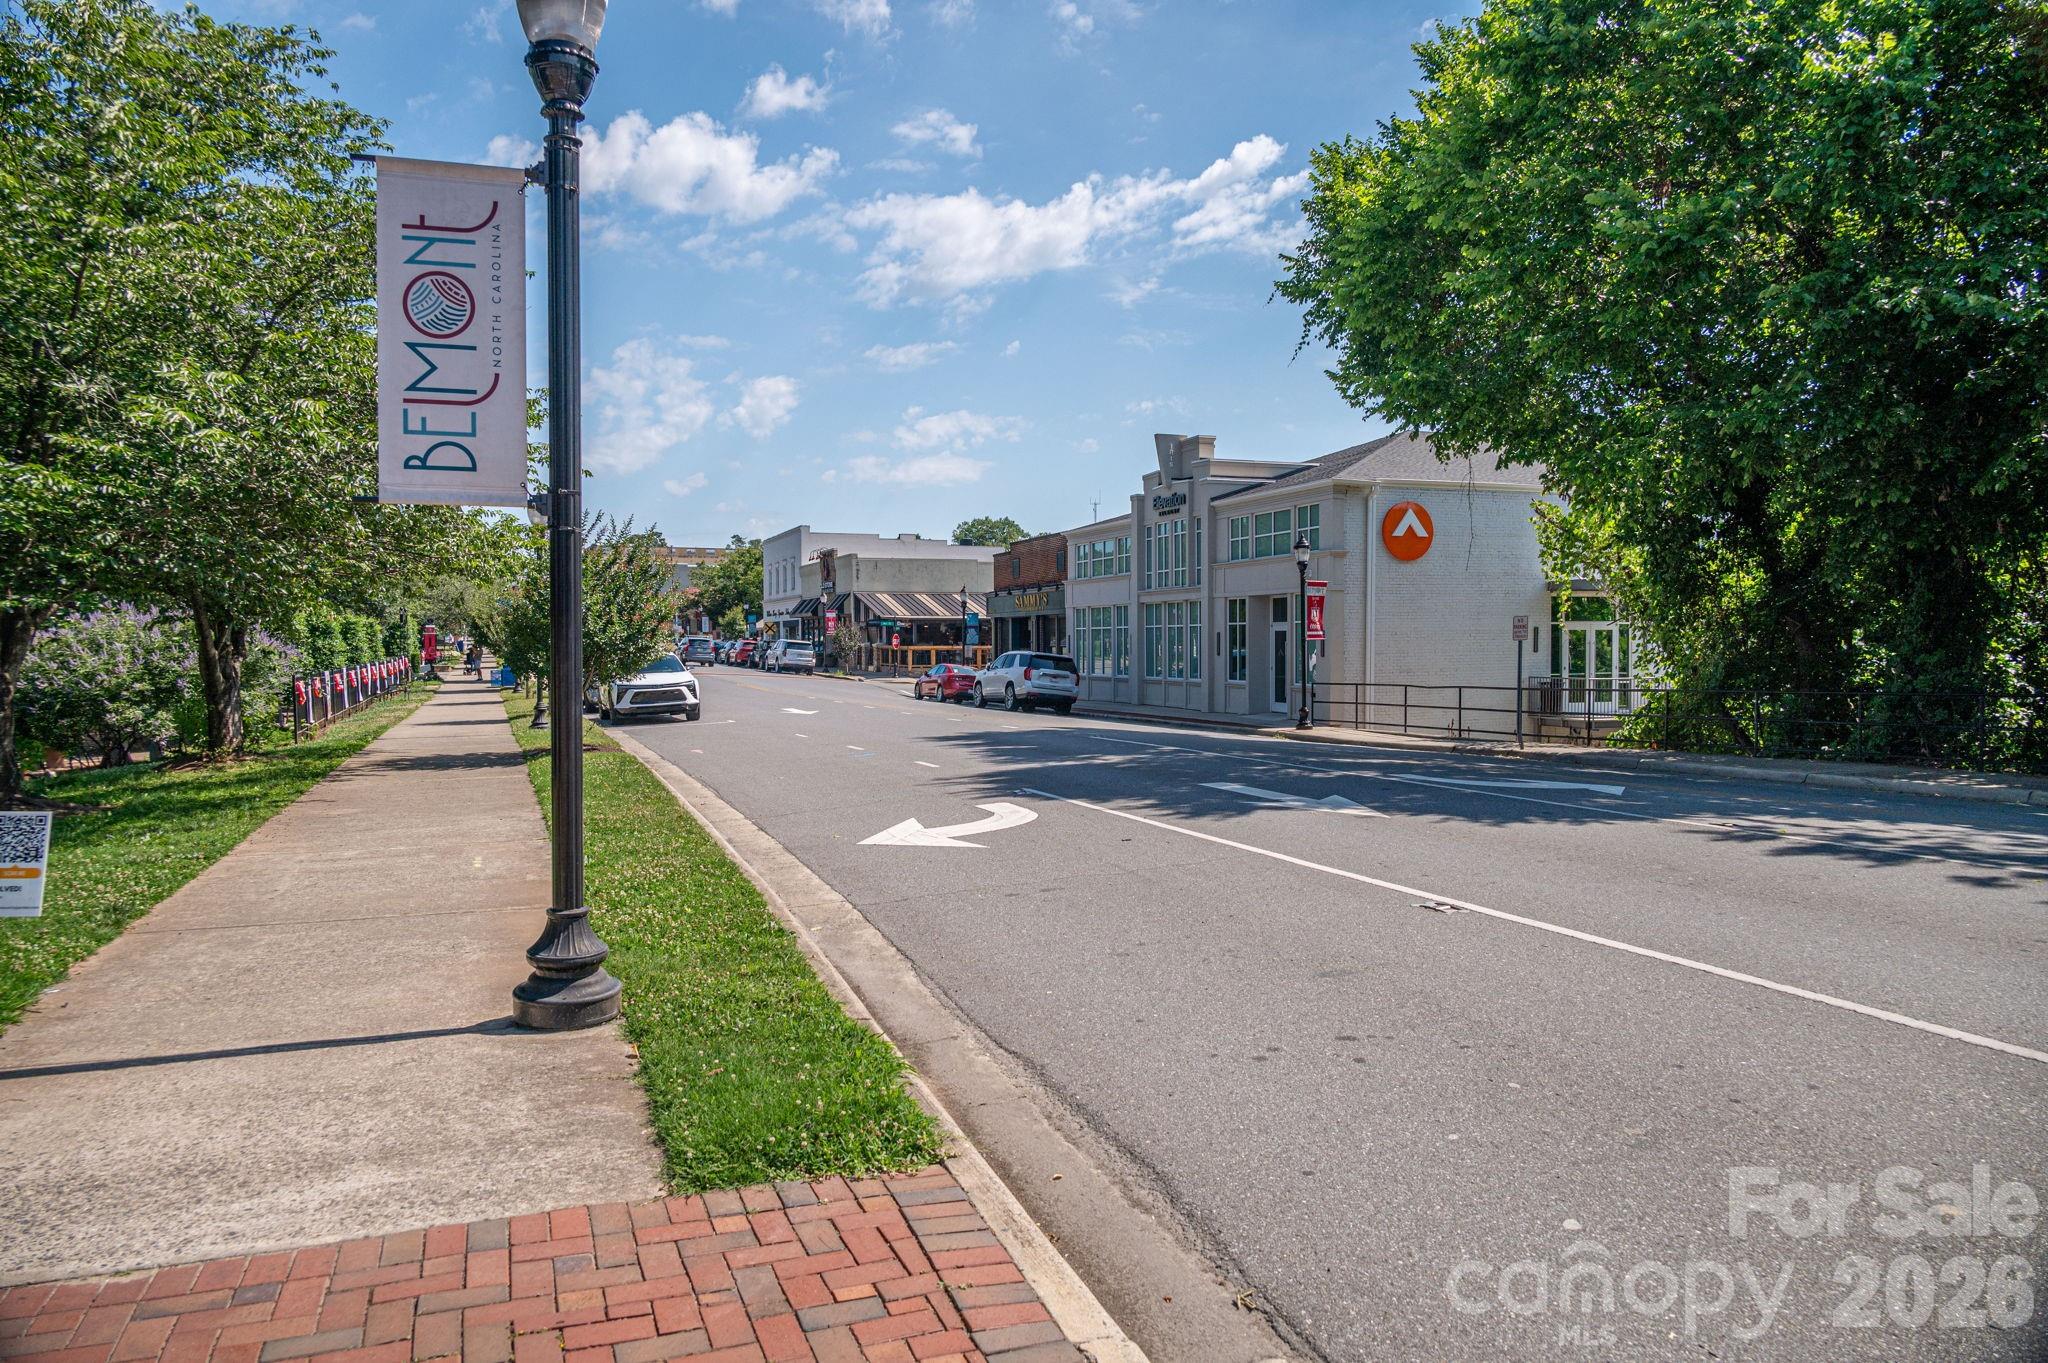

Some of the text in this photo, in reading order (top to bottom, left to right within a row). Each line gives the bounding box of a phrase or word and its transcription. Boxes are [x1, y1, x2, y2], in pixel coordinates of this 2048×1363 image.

[401, 200, 500, 472] BELMONT
[492, 222, 502, 368] NORTH CAROLINA
[1016, 593, 1047, 608] SAMMY'S
